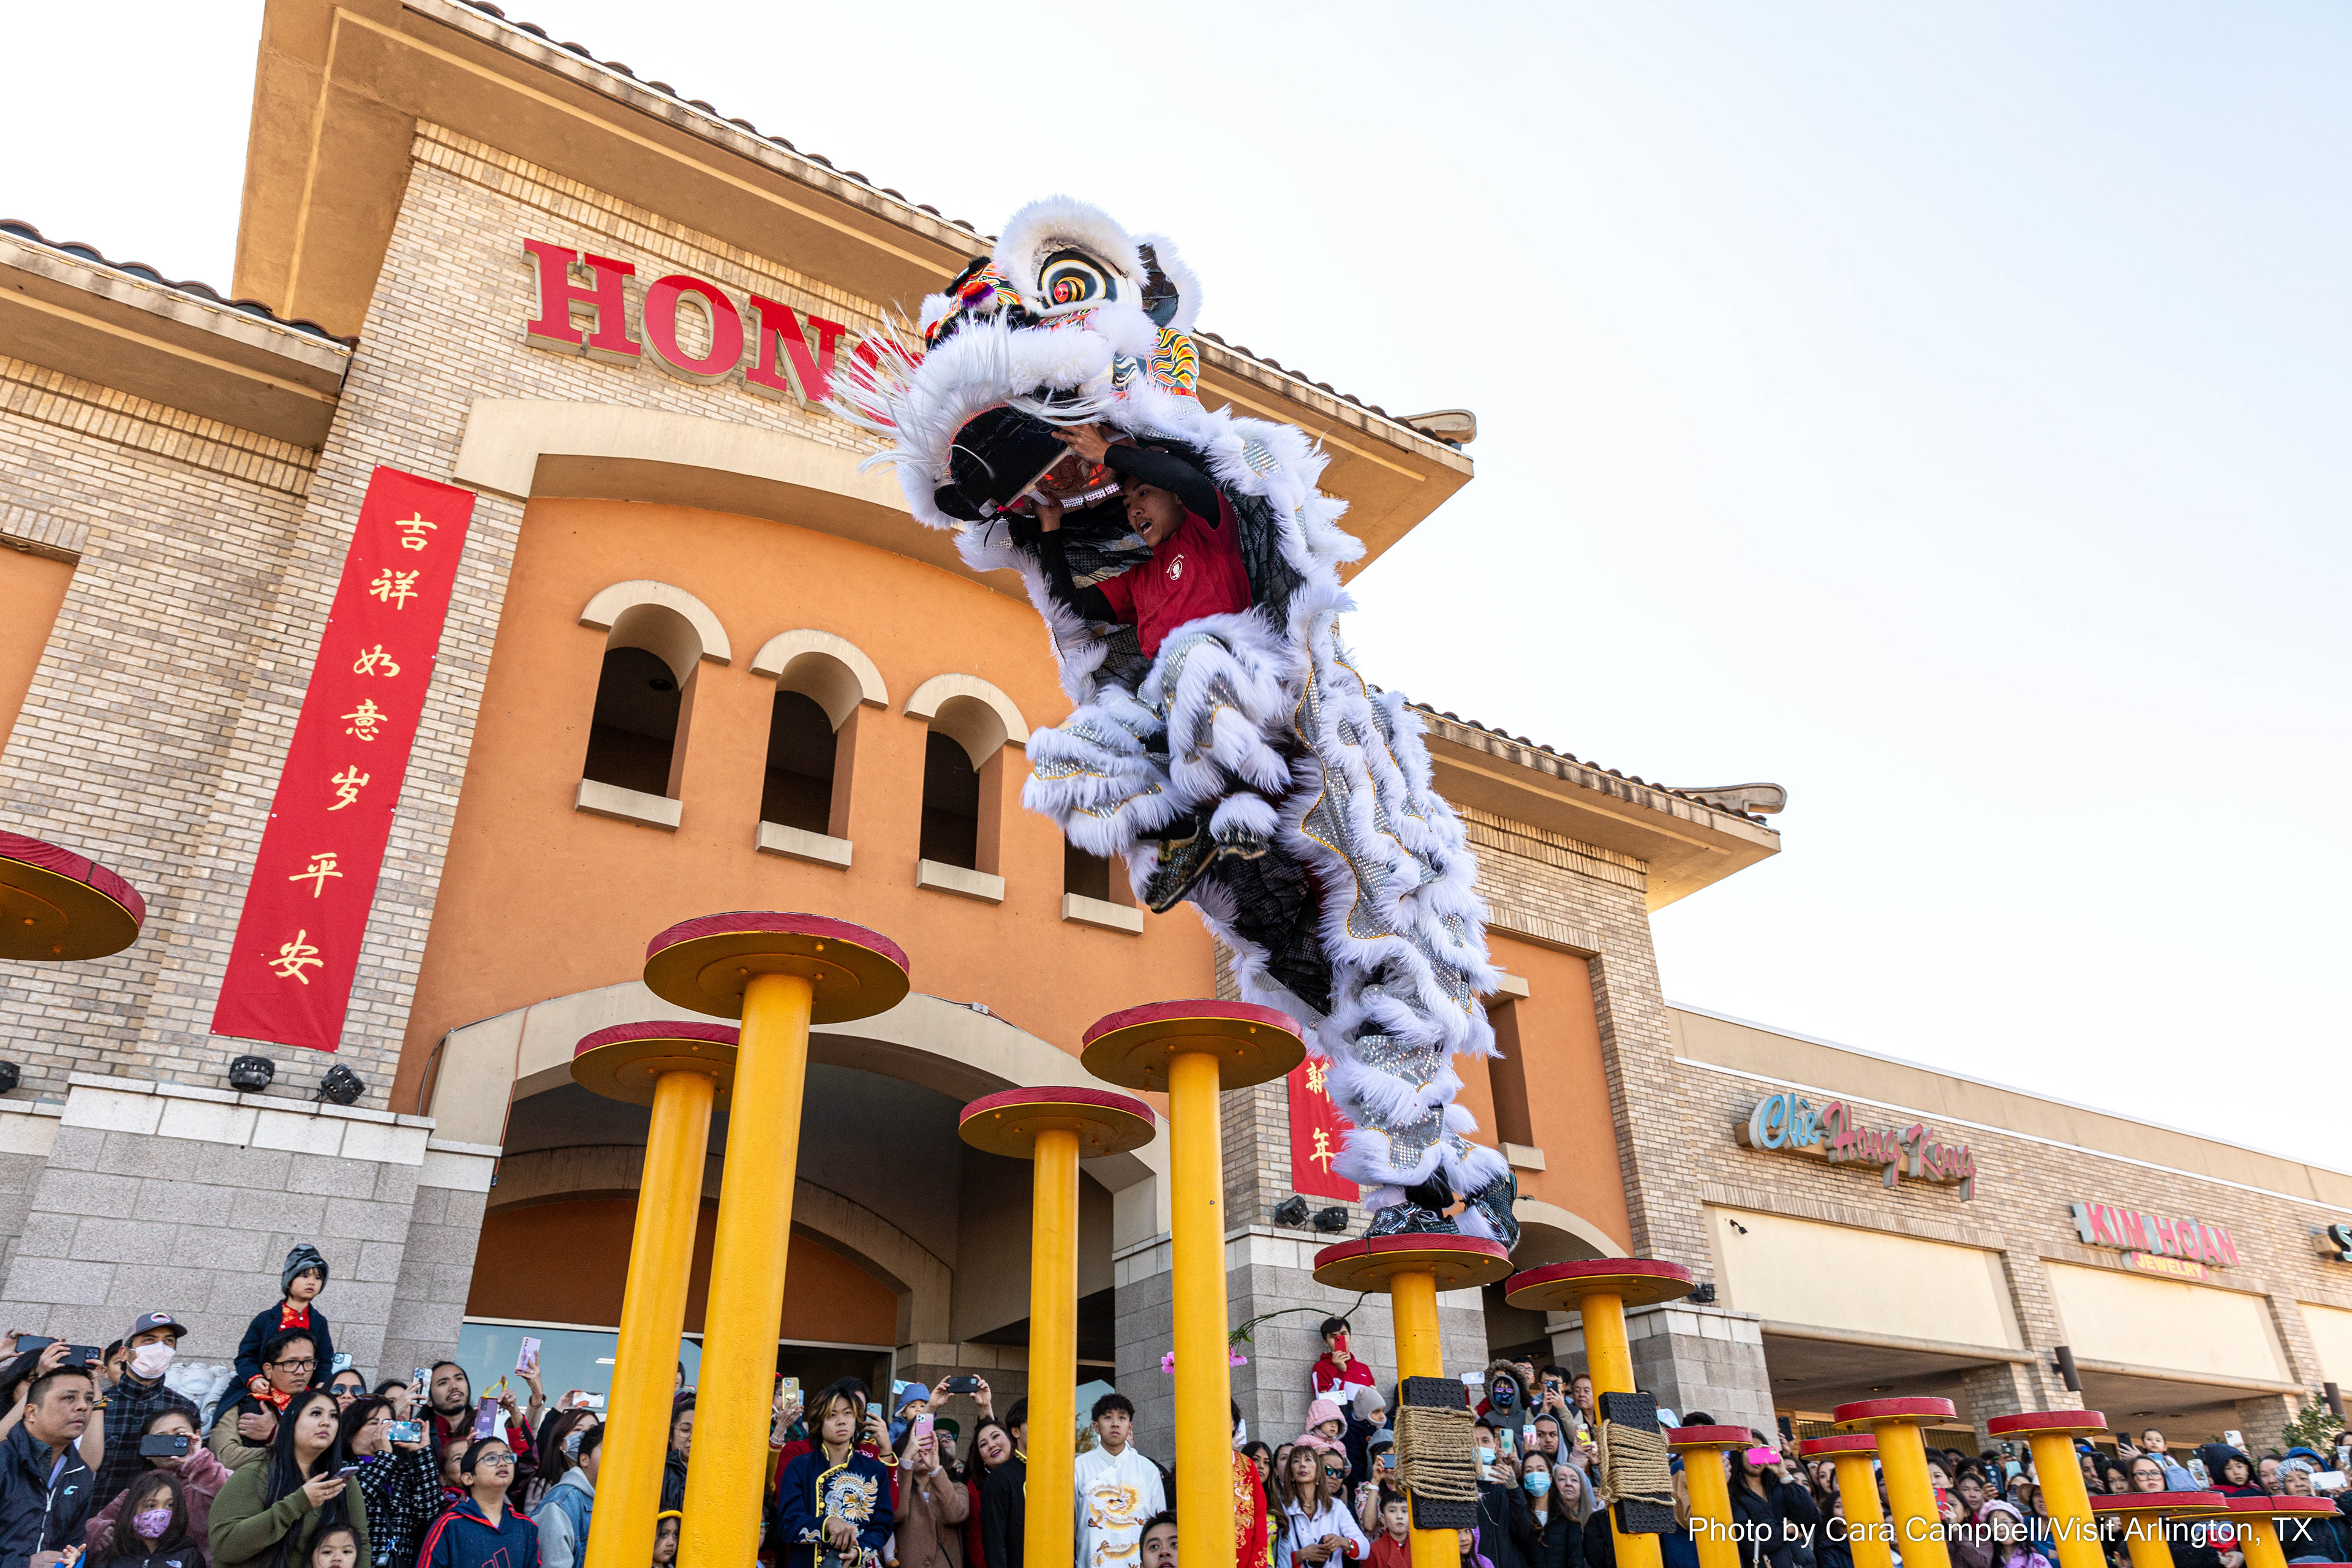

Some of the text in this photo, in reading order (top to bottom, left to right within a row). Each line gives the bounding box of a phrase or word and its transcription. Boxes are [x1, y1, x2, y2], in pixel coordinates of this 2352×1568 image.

[268, 511, 438, 985] 吉祥如意岁平安
[1823, 1101, 1902, 1186] Hong
[1908, 1123, 1977, 1200] Kong
[2084, 1202, 2151, 1251] KIM
[2136, 1253, 2203, 1279] JEWELRY
